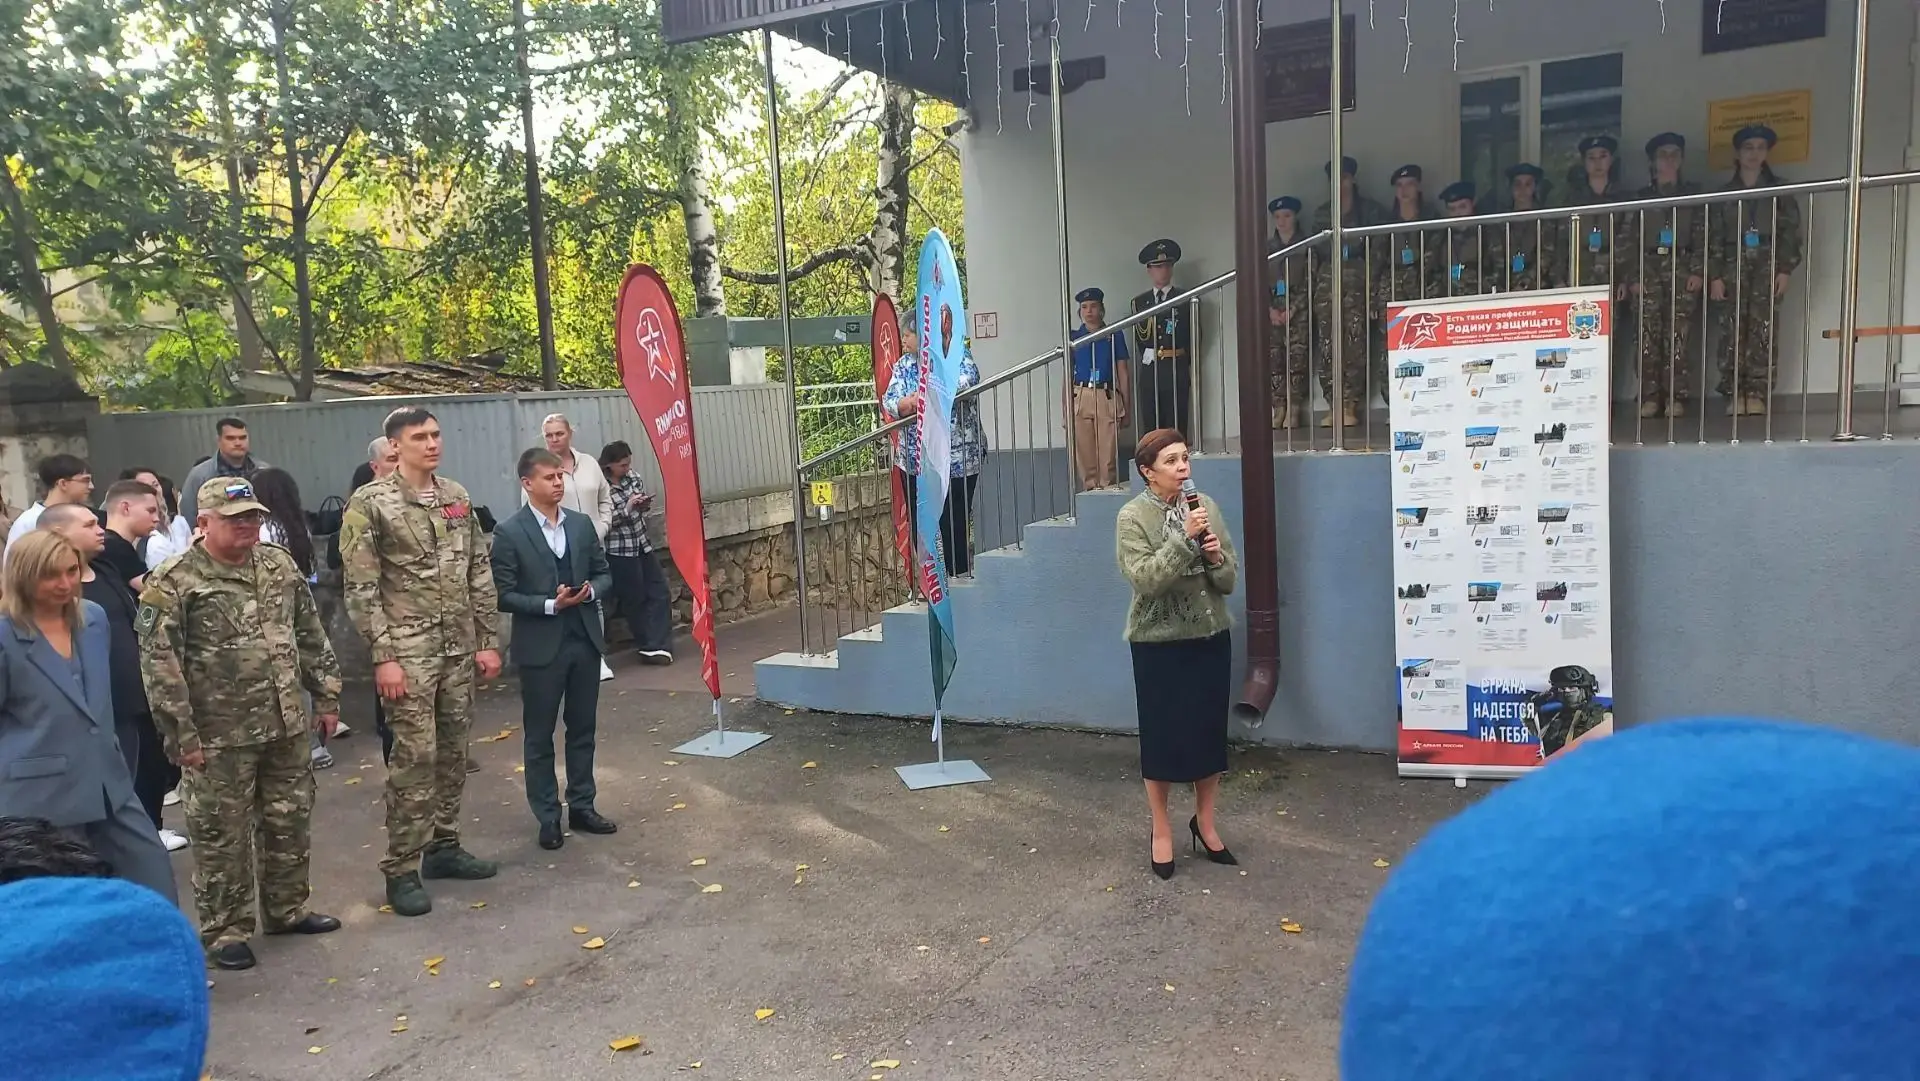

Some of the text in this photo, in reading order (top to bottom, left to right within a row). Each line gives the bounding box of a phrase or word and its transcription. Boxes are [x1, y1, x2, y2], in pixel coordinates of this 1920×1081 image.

[1446, 315, 1465, 323] Есть
[1467, 313, 1489, 321] такая
[1491, 310, 1537, 320] профессия
[1446, 317, 1562, 334] Родину защищать
[1480, 677, 1527, 695] СТРАНА
[1473, 701, 1536, 721] НАДЕЕТСЯ
[1480, 726, 1529, 743] НА ТЕБЯ
